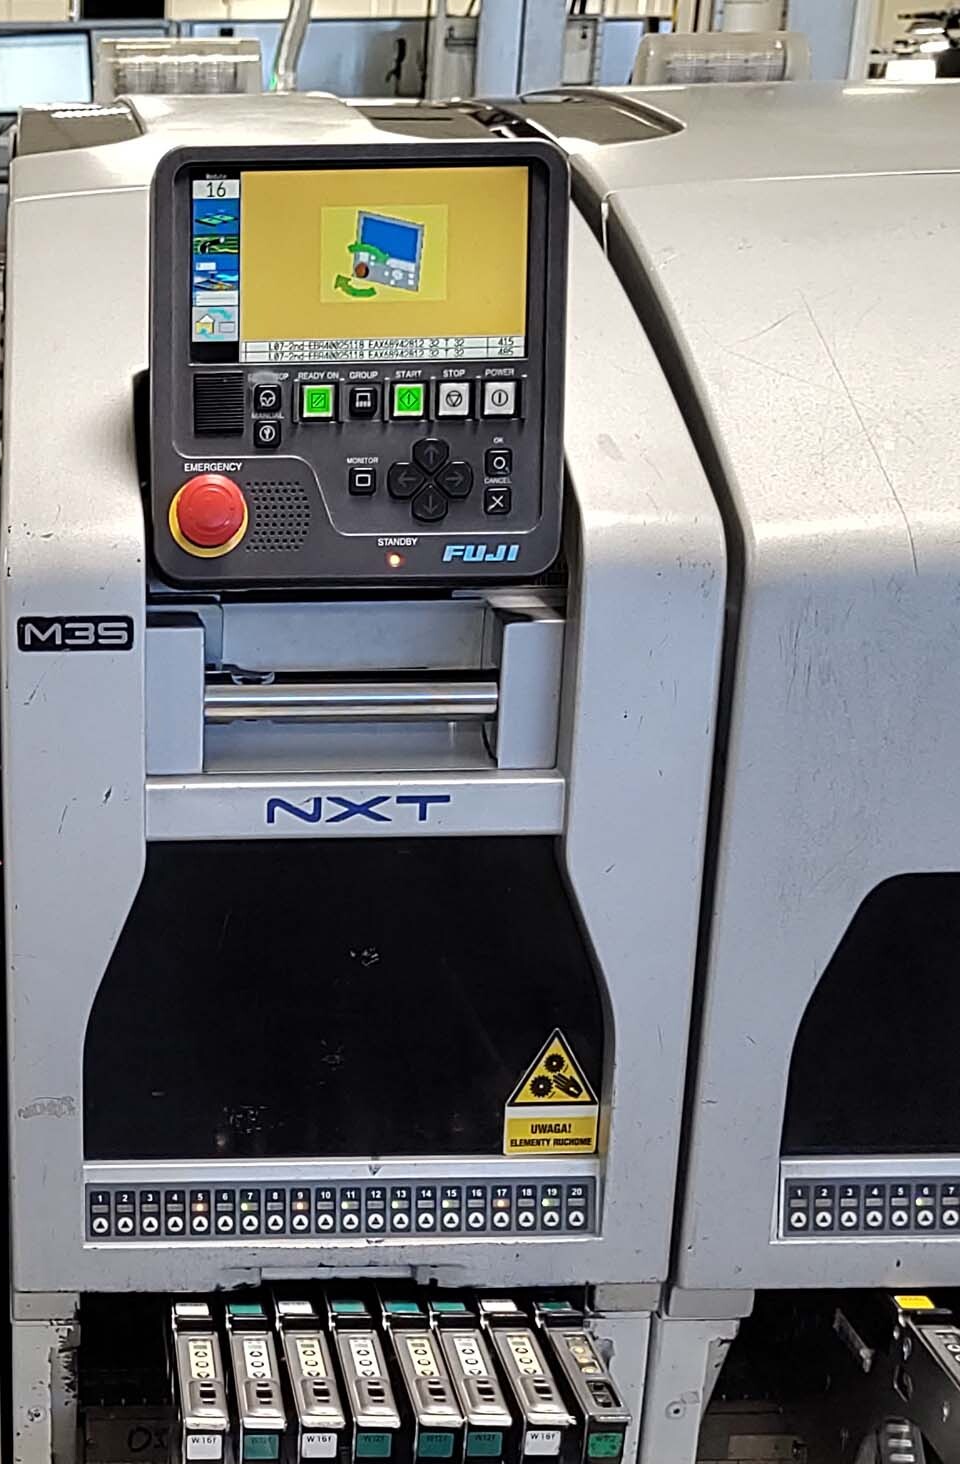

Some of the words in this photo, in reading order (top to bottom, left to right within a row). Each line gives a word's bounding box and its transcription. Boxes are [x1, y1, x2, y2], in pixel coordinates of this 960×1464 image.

[206, 181, 227, 198] 16
[298, 372, 325, 380] READY
[326, 372, 340, 380] ON
[349, 371, 379, 379] GROUP
[395, 370, 422, 378] START
[442, 369, 466, 378] STOP
[485, 368, 515, 377] POWER
[184, 462, 242, 472] EMERGENCY
[377, 537, 419, 546] STANDBY
[442, 544, 520, 562] FUJI
[24, 622, 129, 645] M3S
[266, 795, 451, 824] NXT
[530, 1123, 572, 1134] UWAGA!
[510, 1138, 551, 1147] ELEMENTY
[553, 1137, 592, 1146] RUCHOME
[320, 1191, 331, 1200] 10
[346, 1190, 356, 1199] 11
[370, 1190, 382, 1199] 12
[396, 1189, 407, 1198] 13
[421, 1189, 432, 1198] 14
[446, 1189, 457, 1198] 15
[471, 1188, 483, 1197] 16
[496, 1188, 508, 1197] 17
[521, 1188, 533, 1197] 18
[547, 1188, 558, 1196] 19
[571, 1187, 583, 1196] 20
